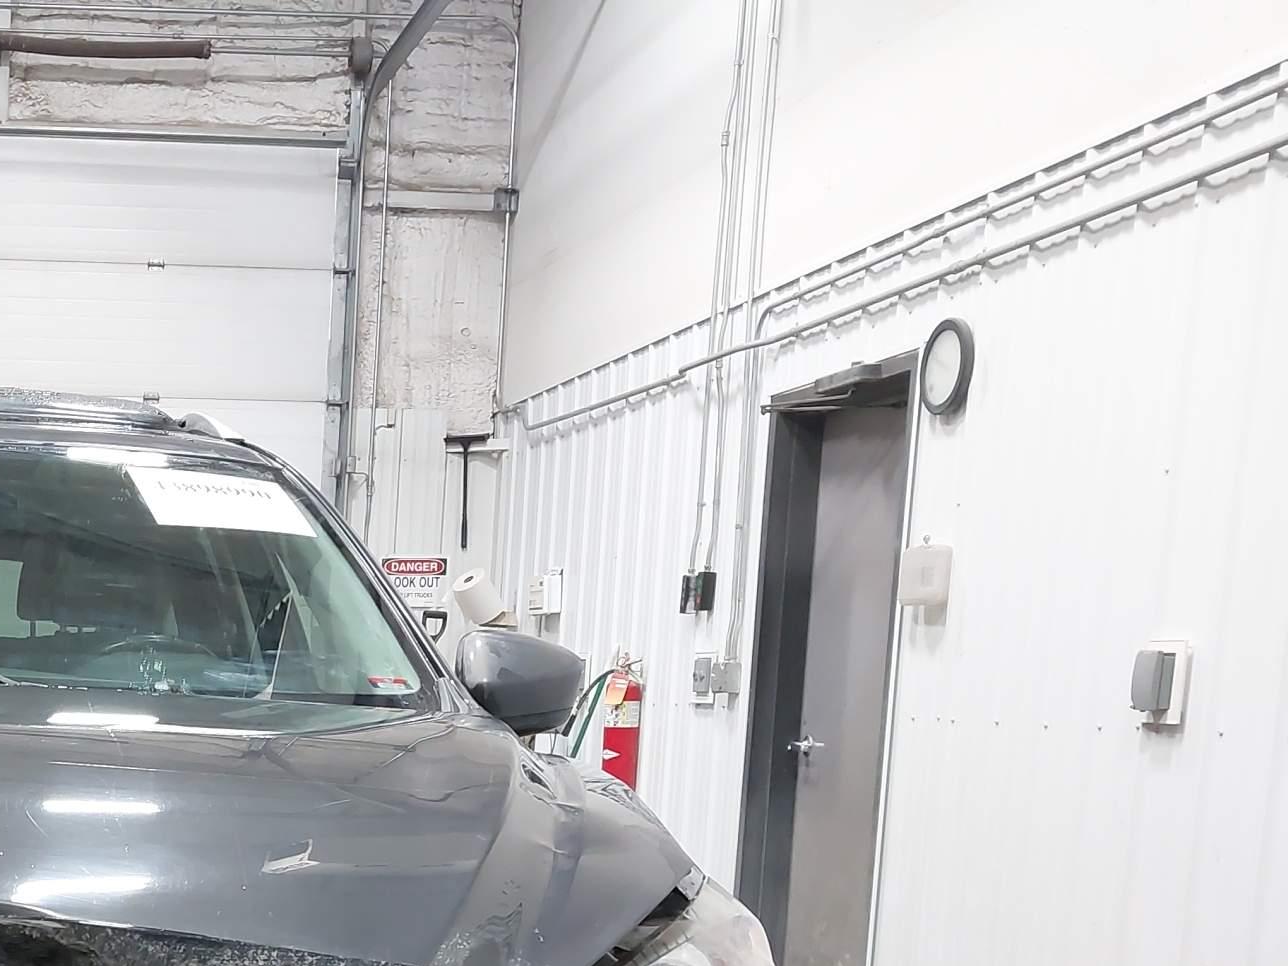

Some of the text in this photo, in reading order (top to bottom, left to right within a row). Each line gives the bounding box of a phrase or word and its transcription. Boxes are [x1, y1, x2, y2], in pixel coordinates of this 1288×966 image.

[391, 562, 439, 572] DANGER
[394, 576, 441, 588] OOK OUT
